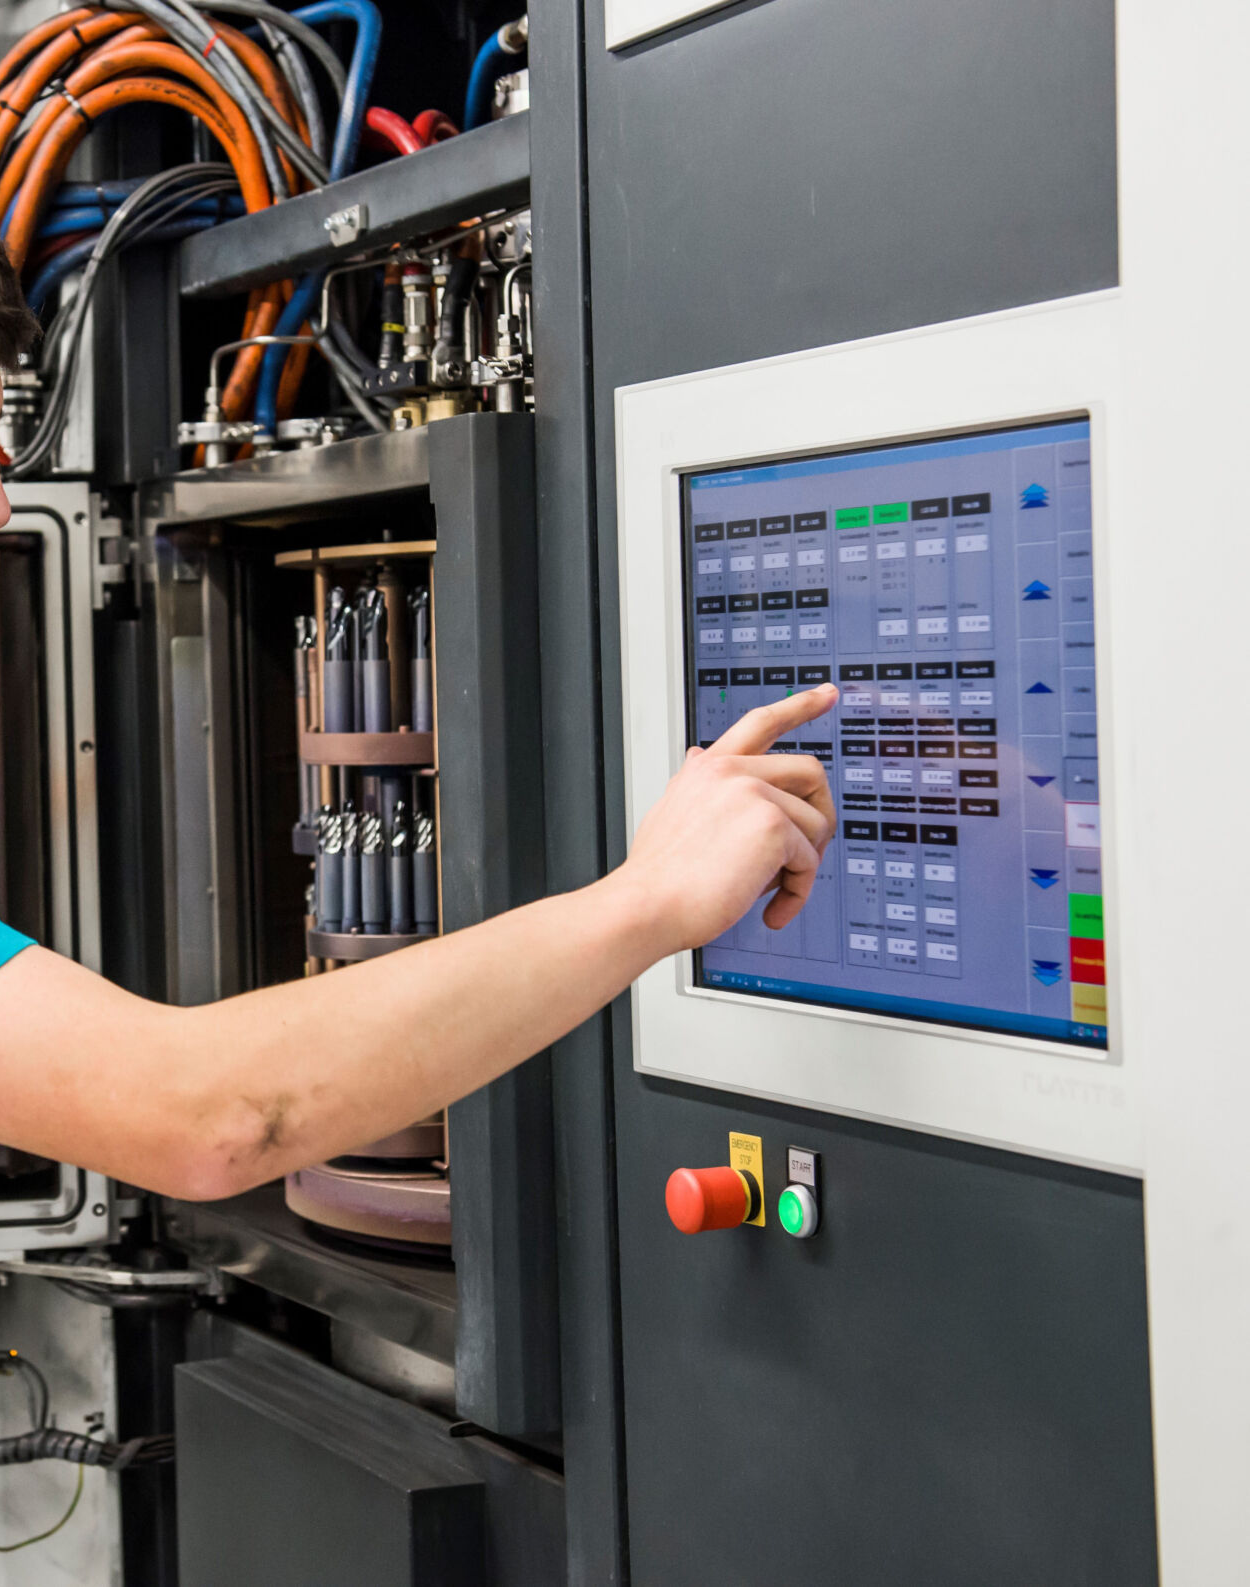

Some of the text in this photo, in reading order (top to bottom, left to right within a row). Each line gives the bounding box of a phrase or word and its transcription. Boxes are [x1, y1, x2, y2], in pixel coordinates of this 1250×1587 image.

[731, 1138, 758, 1153] EMERGENCY
[739, 1154, 752, 1166] STOP
[791, 1159, 812, 1173] START
